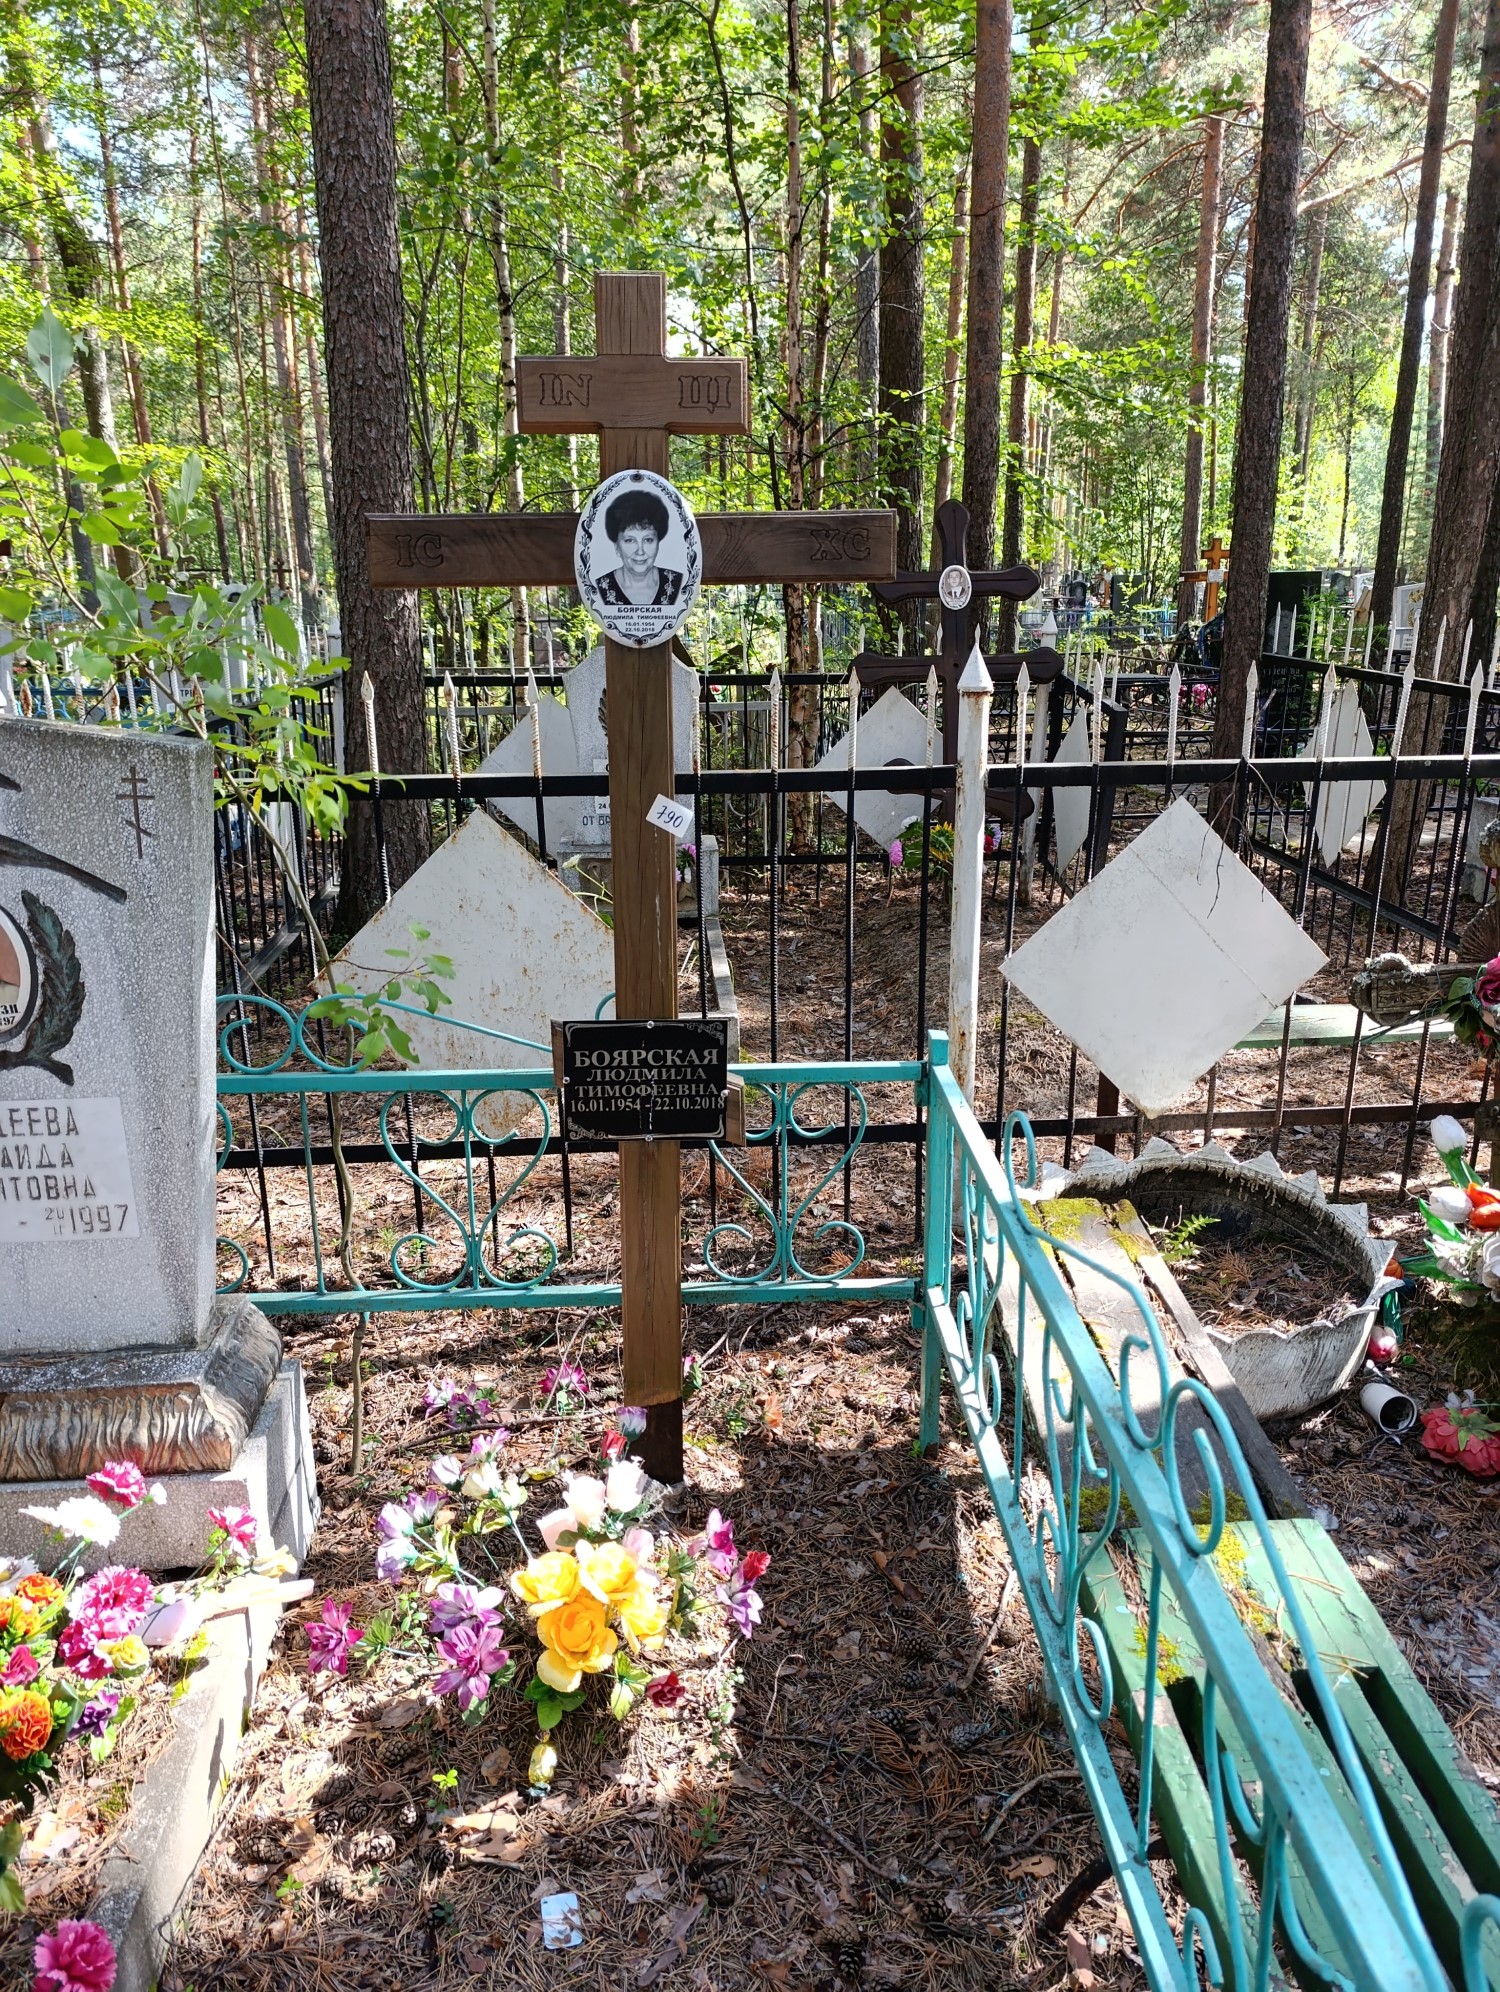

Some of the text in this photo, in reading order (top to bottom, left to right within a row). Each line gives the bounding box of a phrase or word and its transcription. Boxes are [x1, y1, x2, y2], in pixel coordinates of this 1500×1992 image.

[656, 804, 684, 828] 790
[0, 1016, 16, 1026] 97
[574, 1048, 719, 1068] БОЯРСКАЯ
[586, 1067, 707, 1083] ЛЮДМИЛА
[575, 1083, 719, 1098] ТИМОФЕЕВНА
[571, 1099, 641, 1112] 16.01.1954
[654, 1096, 725, 1111] 22.10.2018
[0, 1143, 74, 1170] АИДА
[69, 1203, 129, 1234] 1997
